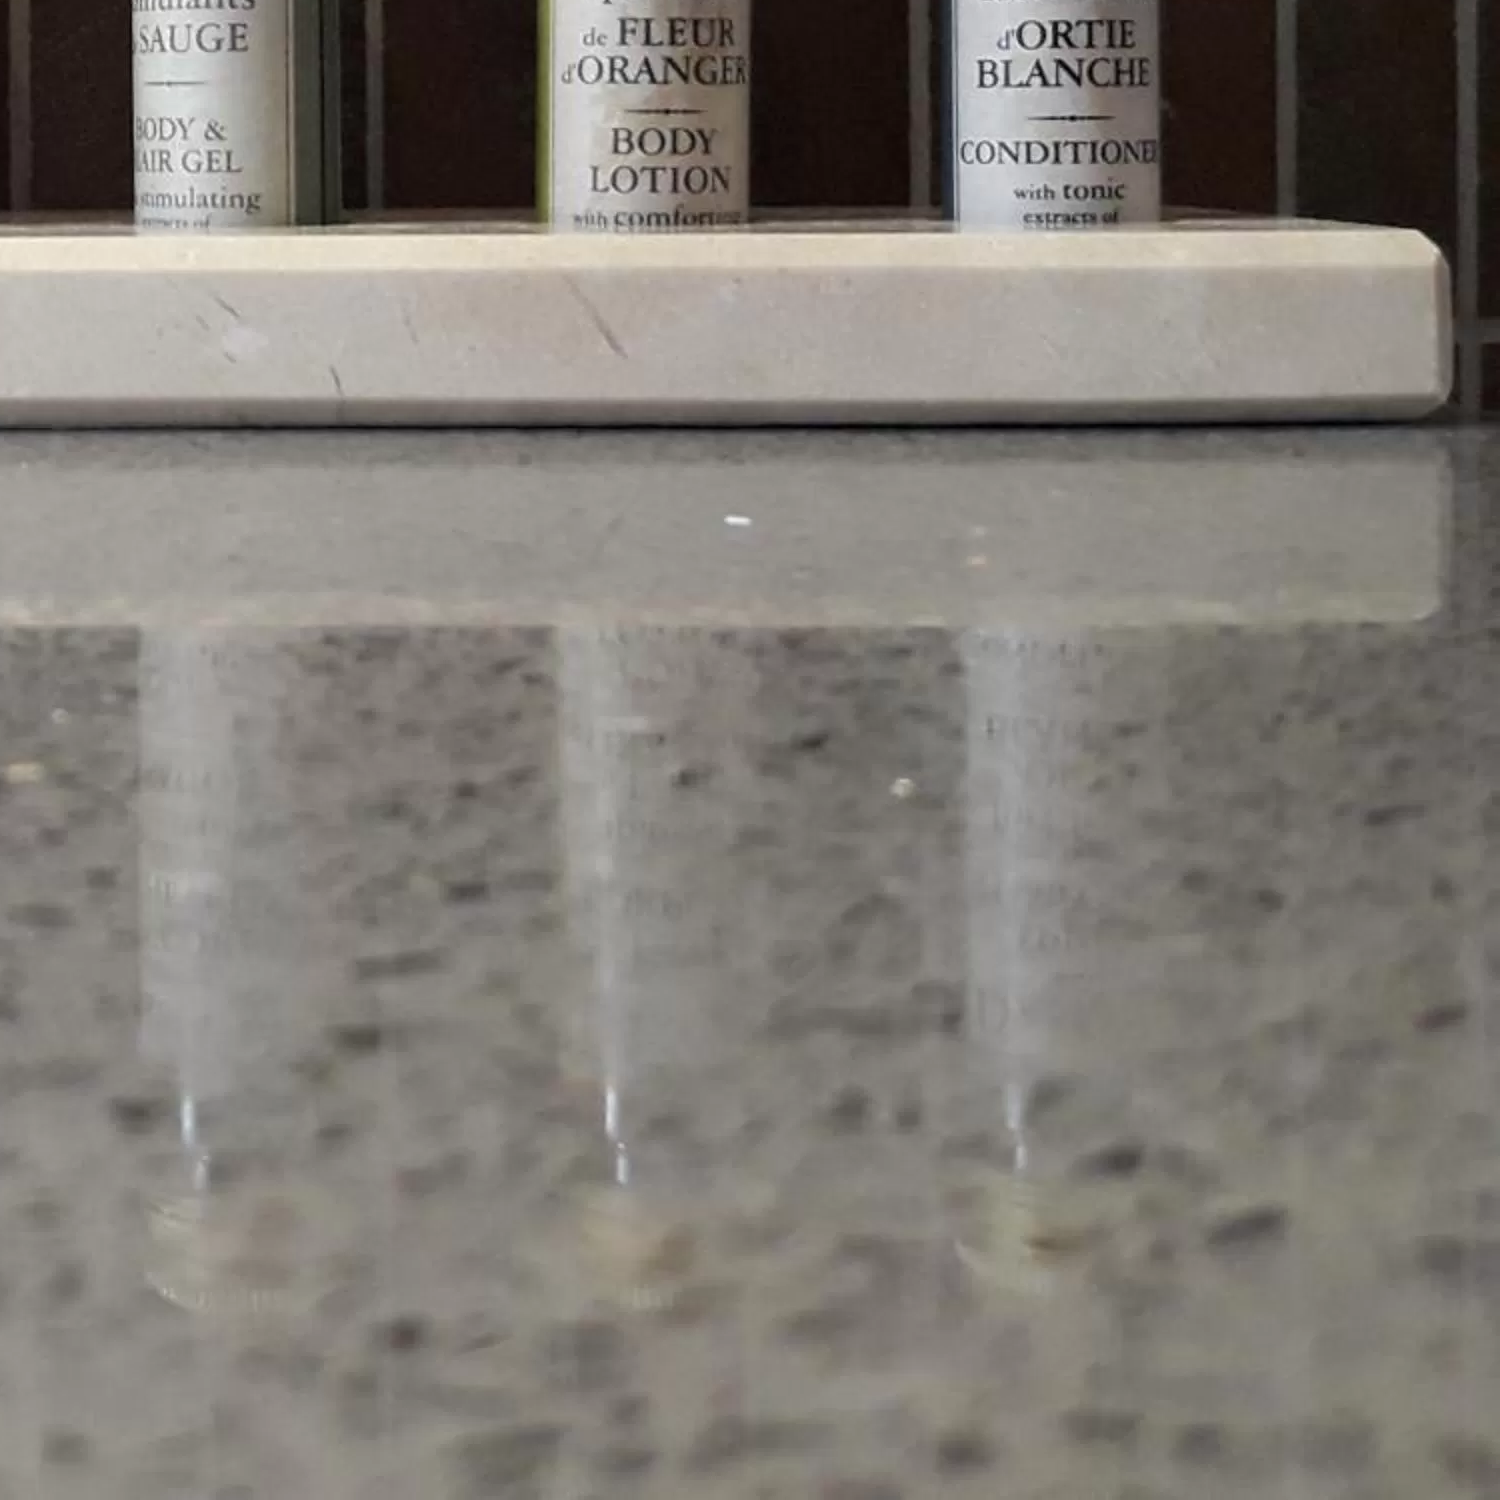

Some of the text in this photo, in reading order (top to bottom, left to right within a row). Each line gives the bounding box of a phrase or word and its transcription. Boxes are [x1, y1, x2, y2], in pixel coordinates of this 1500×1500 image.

[138, 22, 249, 54] SAUGE
[582, 17, 735, 47] de FLEUR
[997, 19, 1136, 51] d'ORTIE
[977, 57, 1151, 88] BLANCHE
[204, 119, 227, 141] &
[611, 128, 719, 156] BODY
[181, 149, 243, 174] GEL
[960, 139, 1157, 166] CONDITIONE
[590, 166, 732, 195] LOTION
[1013, 177, 1125, 200] with tonic
